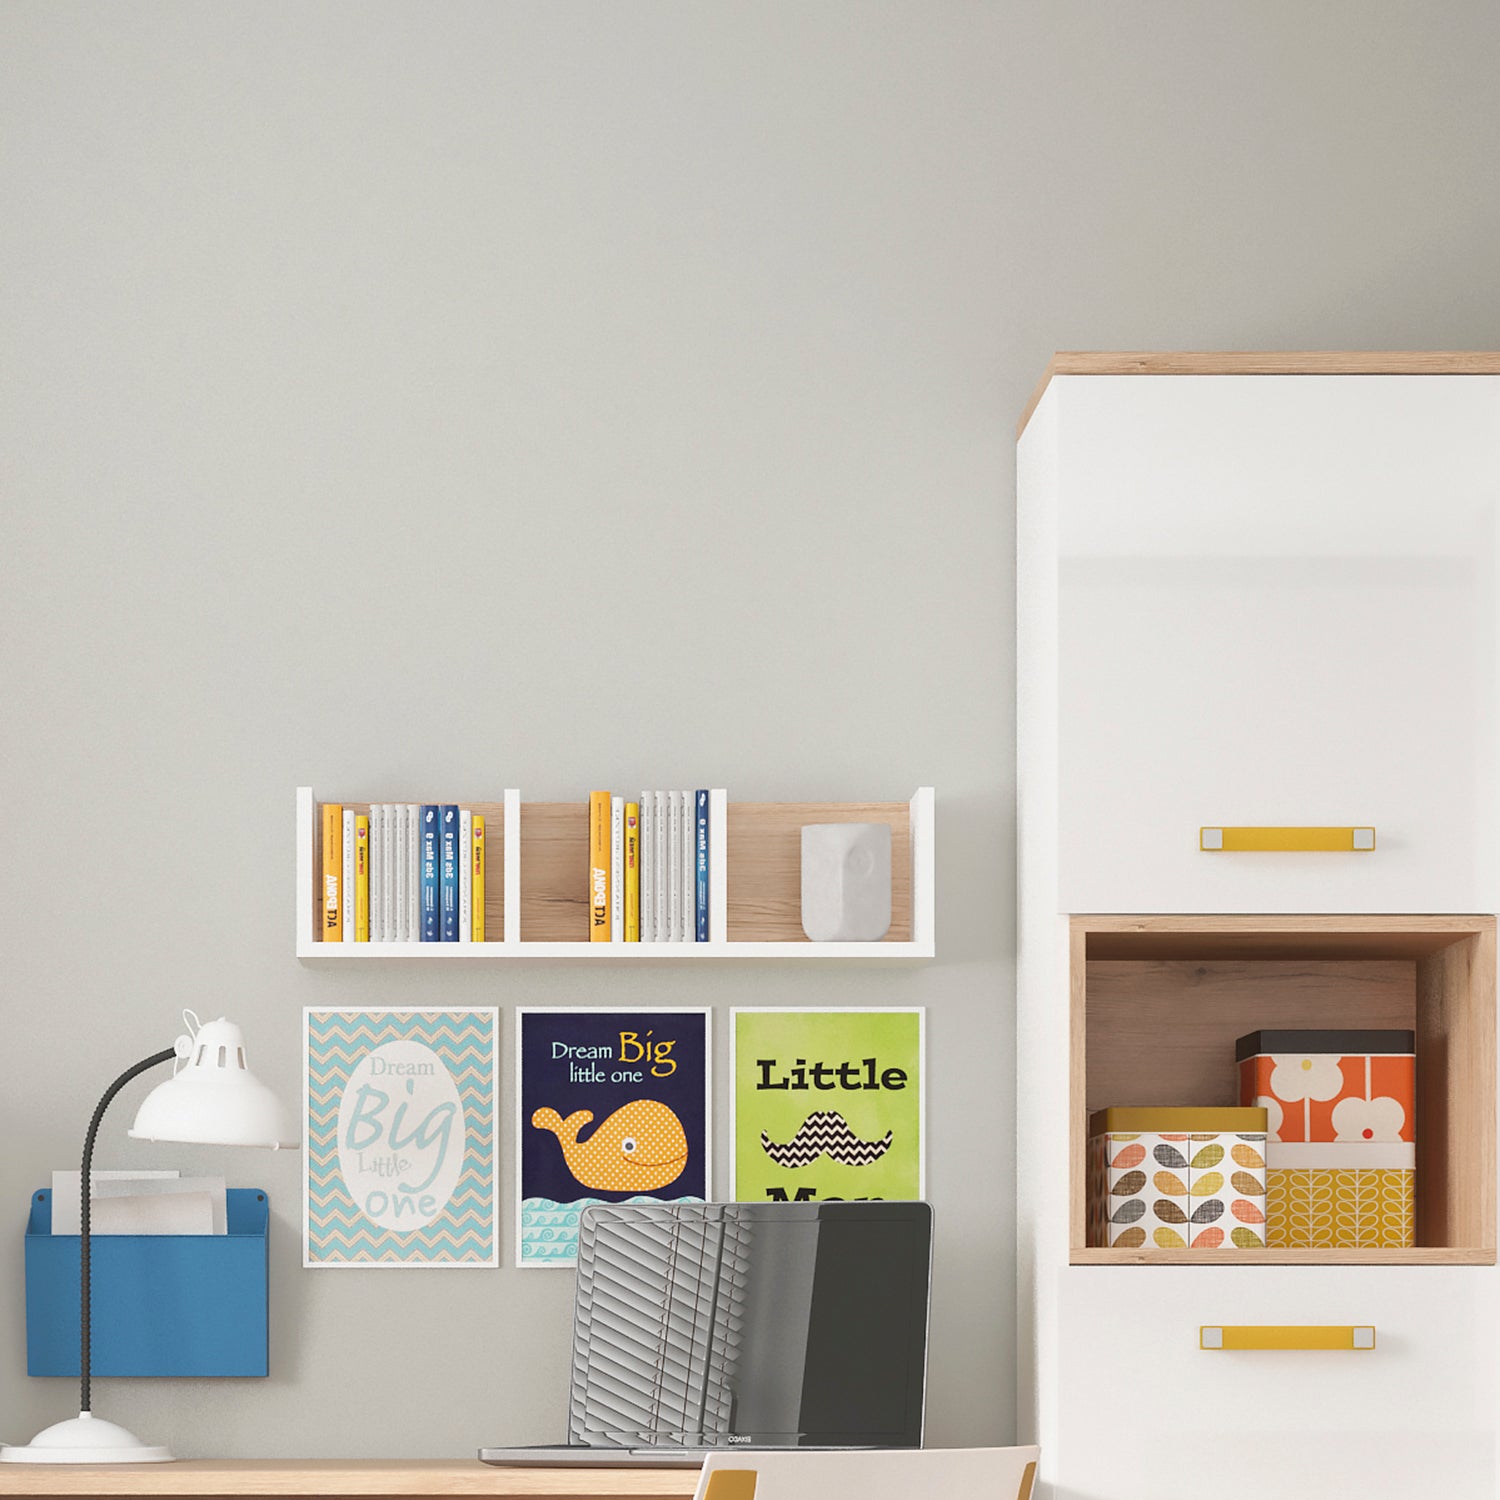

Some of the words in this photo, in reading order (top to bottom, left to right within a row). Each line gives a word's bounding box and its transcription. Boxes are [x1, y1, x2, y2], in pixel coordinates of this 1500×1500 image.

[370, 1057, 434, 1076] Dream
[552, 1042, 613, 1060] Dream
[618, 1030, 678, 1077] Big
[569, 1062, 606, 1083] little
[610, 1070, 643, 1083] one
[757, 1058, 908, 1091] Little
[345, 1079, 457, 1194] Big
[356, 1152, 412, 1177] Little
[365, 1191, 437, 1218] one
